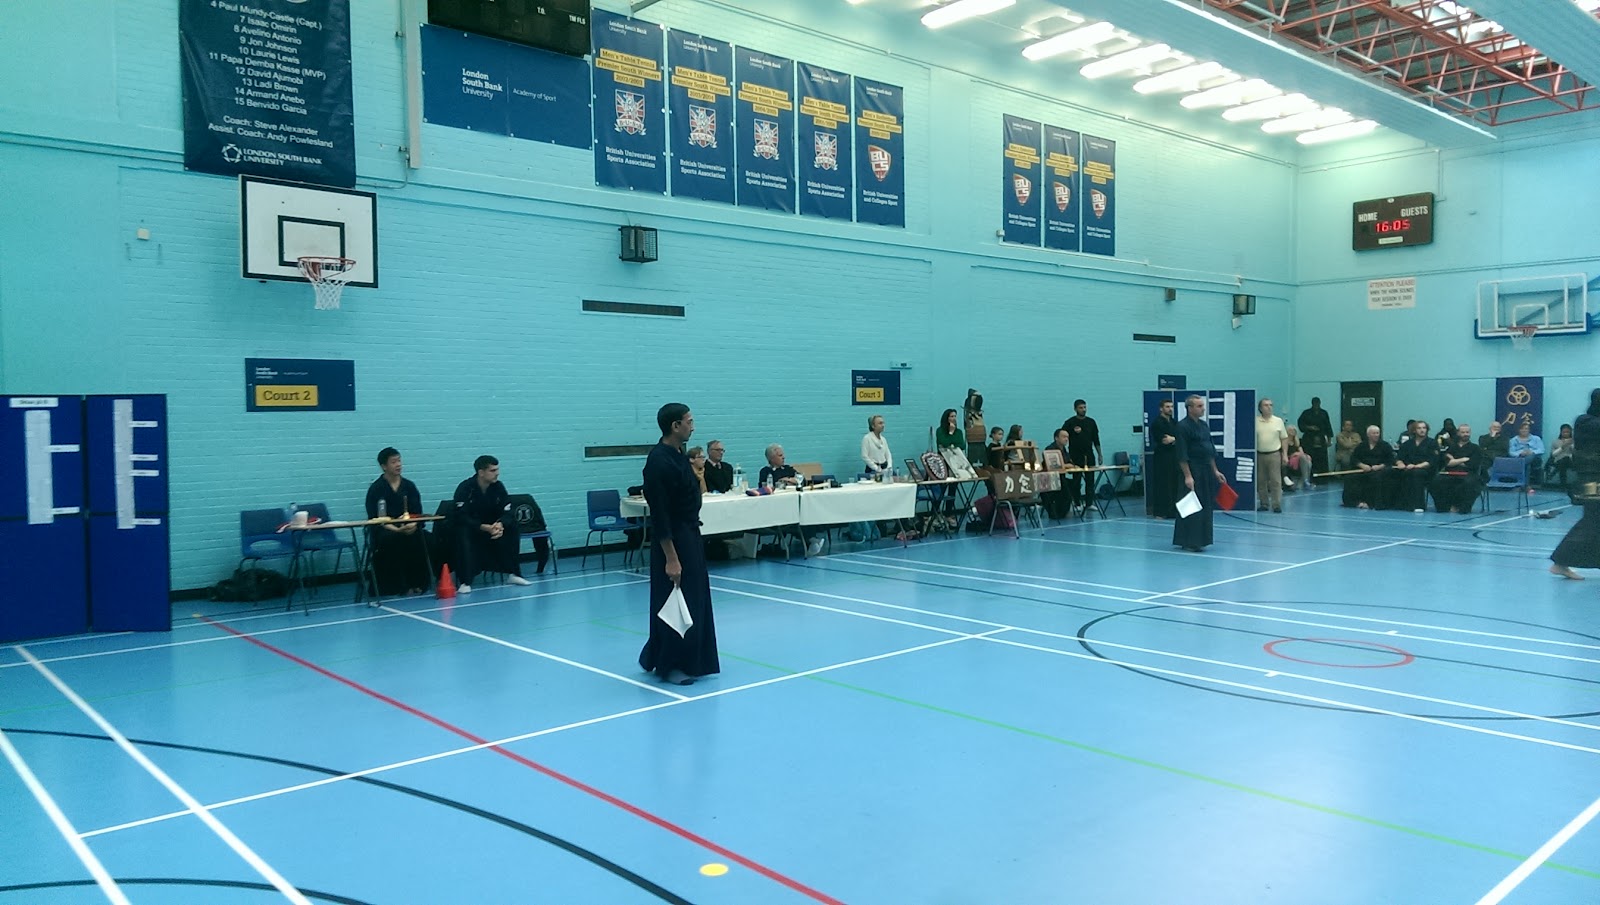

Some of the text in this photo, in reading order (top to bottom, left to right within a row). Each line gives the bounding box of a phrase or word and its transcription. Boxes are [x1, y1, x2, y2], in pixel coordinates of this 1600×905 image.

[219, 2, 238, 12] Paul
[240, 6, 294, 24] Mundy-Castle
[296, 17, 322, 30] (Capt.)
[248, 16, 269, 28] Isaac
[241, 26, 270, 38] Avelino
[272, 33, 302, 45] Antonio
[240, 36, 297, 54] 9 Jon Johnson
[238, 46, 300, 64] 10 Laurie Lewis
[602, 50, 654, 68] Men's Table Tennis
[209, 52, 326, 80] 11 Papa Demba Kasse (MVP)
[235, 66, 304, 85] 12 David Ajumobi
[462, 68, 489, 80] London
[242, 78, 298, 94] 13 Ladi Brown
[462, 77, 503, 92] South Bank
[235, 87, 305, 104] 14 Armand Anebo
[462, 86, 494, 100] University
[513, 88, 536, 99] Academy
[543, 93, 556, 102] Sport
[246, 99, 280, 110] Benvido
[282, 104, 308, 115] Garcia
[223, 115, 318, 136] Coach: Steve Alexander
[208, 123, 334, 148] Assist. Coach: Andy Powlesland
[244, 148, 322, 164] LONDON SOUTH BANK
[244, 156, 284, 166] UNIVERSITY
[606, 146, 656, 161] British Universities
[607, 154, 655, 168] Sports Association
[680, 159, 726, 172] British Universities
[681, 167, 725, 179] Sports Association
[746, 170, 787, 183] British Universities
[746, 178, 787, 190] Sports Association
[1358, 212, 1378, 222] HOME
[1401, 206, 1428, 217] GUESTS
[264, 390, 311, 400] Court 2
